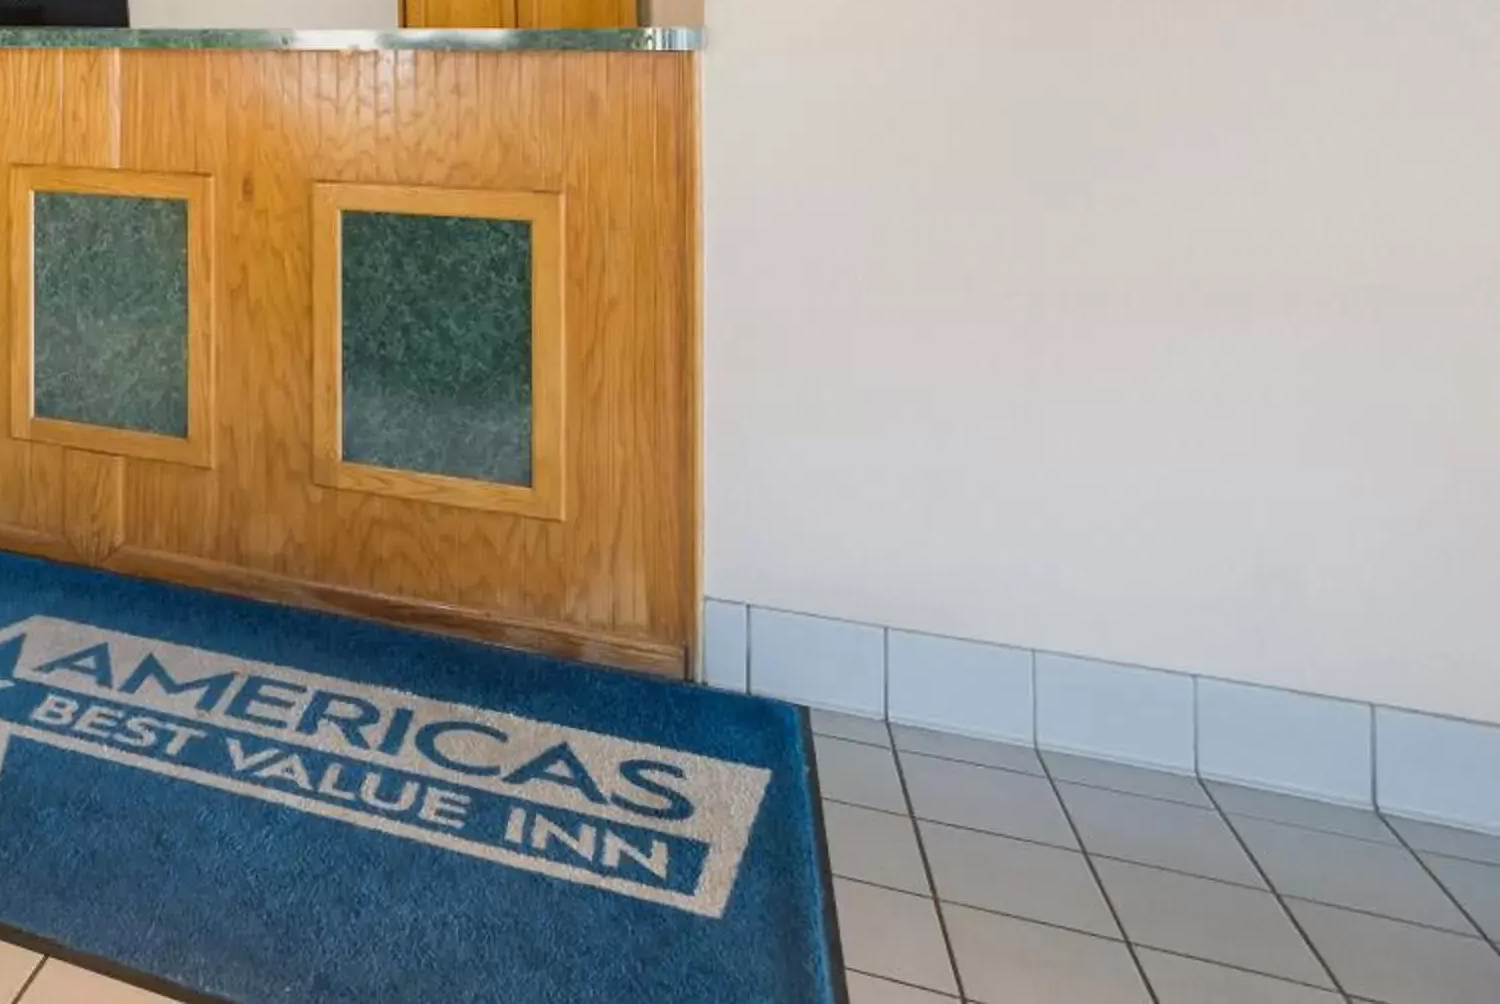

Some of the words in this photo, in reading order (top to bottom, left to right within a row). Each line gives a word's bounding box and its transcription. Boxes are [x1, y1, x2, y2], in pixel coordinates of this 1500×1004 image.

[30, 693, 205, 757] BEST
[226, 737, 472, 830] VALUE
[504, 807, 669, 881] INN
[32, 641, 696, 821] AMERICAS
